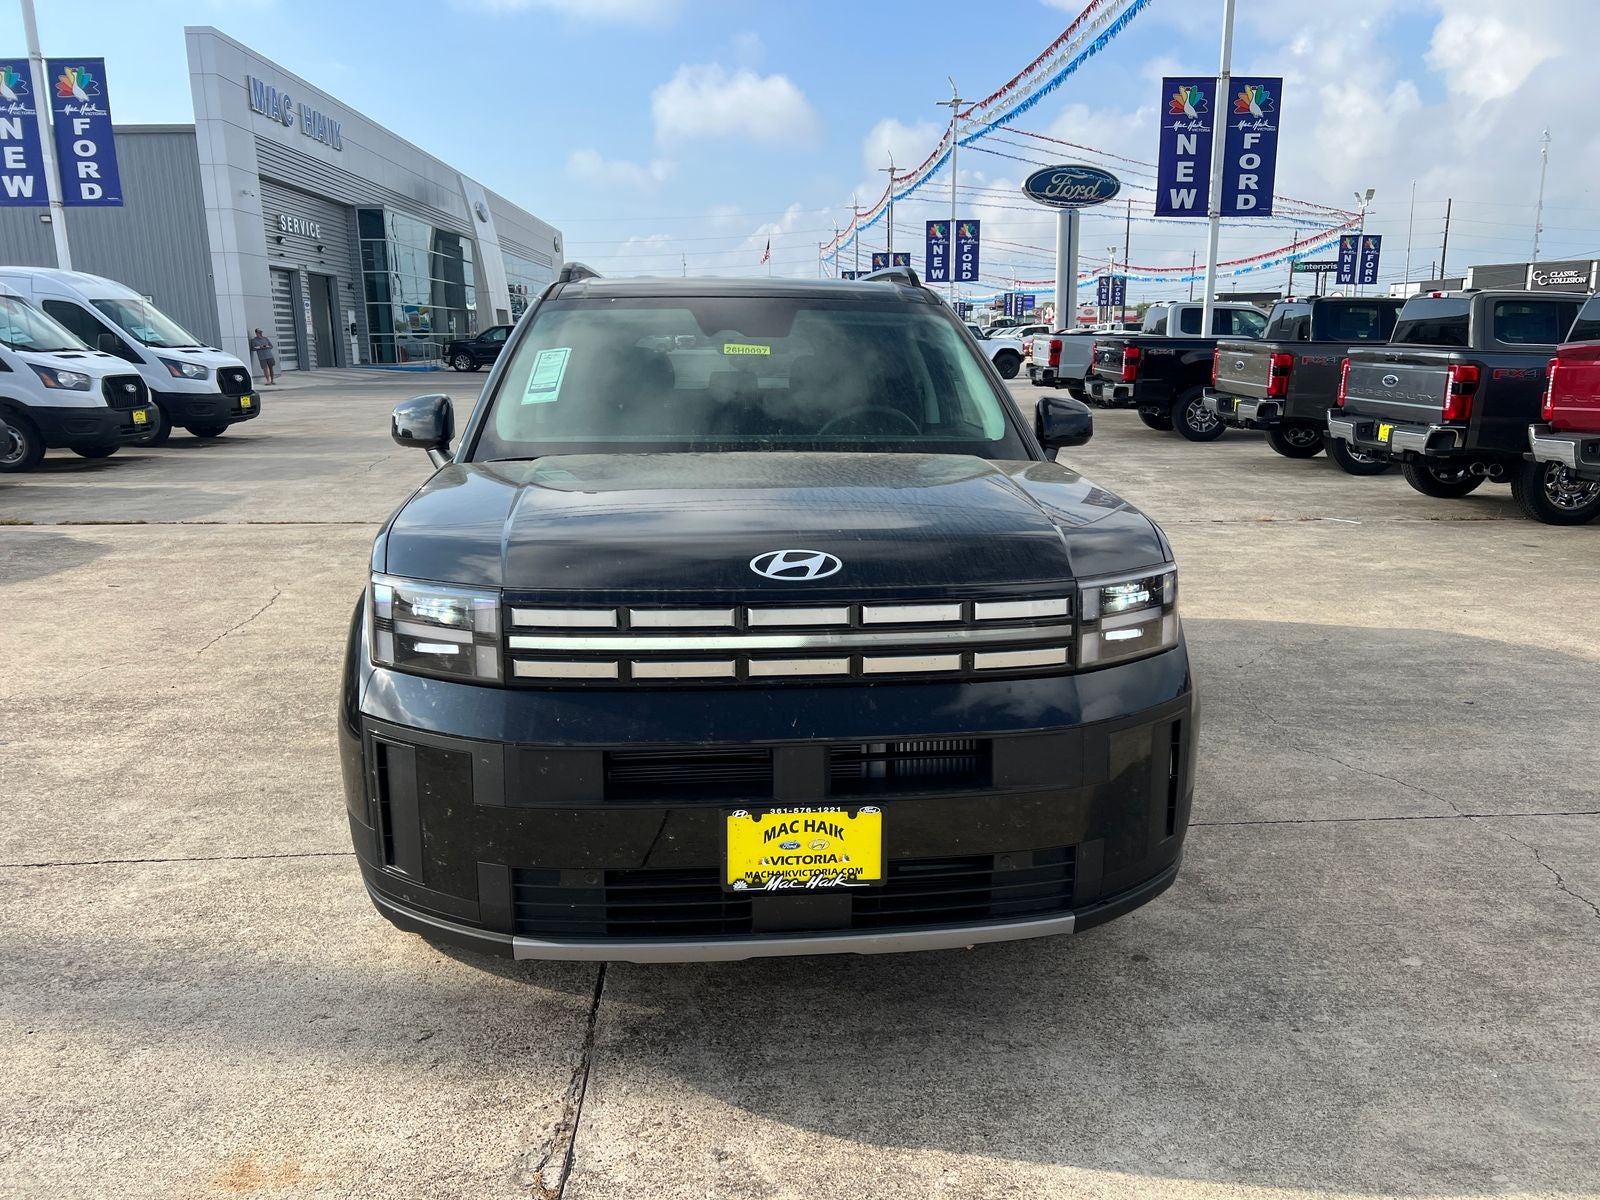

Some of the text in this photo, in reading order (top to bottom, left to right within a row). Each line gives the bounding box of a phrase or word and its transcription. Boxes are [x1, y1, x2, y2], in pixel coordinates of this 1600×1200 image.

[247, 75, 342, 151] MAC HAIK
[0, 117, 33, 198] NEW
[72, 118, 103, 200] FORD
[1170, 133, 1197, 210] NEW
[1236, 133, 1261, 210] FORD
[1045, 173, 1102, 200] Ford
[279, 214, 321, 239] SERVICE
[931, 244, 944, 279] NEW
[962, 244, 972, 279] FORD
[1295, 263, 1338, 271] enterpris
[1341, 254, 1352, 283] NEW
[1364, 254, 1374, 283] FORD
[1550, 270, 1579, 278] CLASSIC
[1549, 276, 1587, 284] COLLISION
[1493, 368, 1538, 379] FX4
[1349, 387, 1438, 401] SUPER DUTY
[763, 820, 845, 844] MAC HAIK
[770, 854, 838, 866] VICTORIA
[764, 873, 850, 891] Mac Haik
